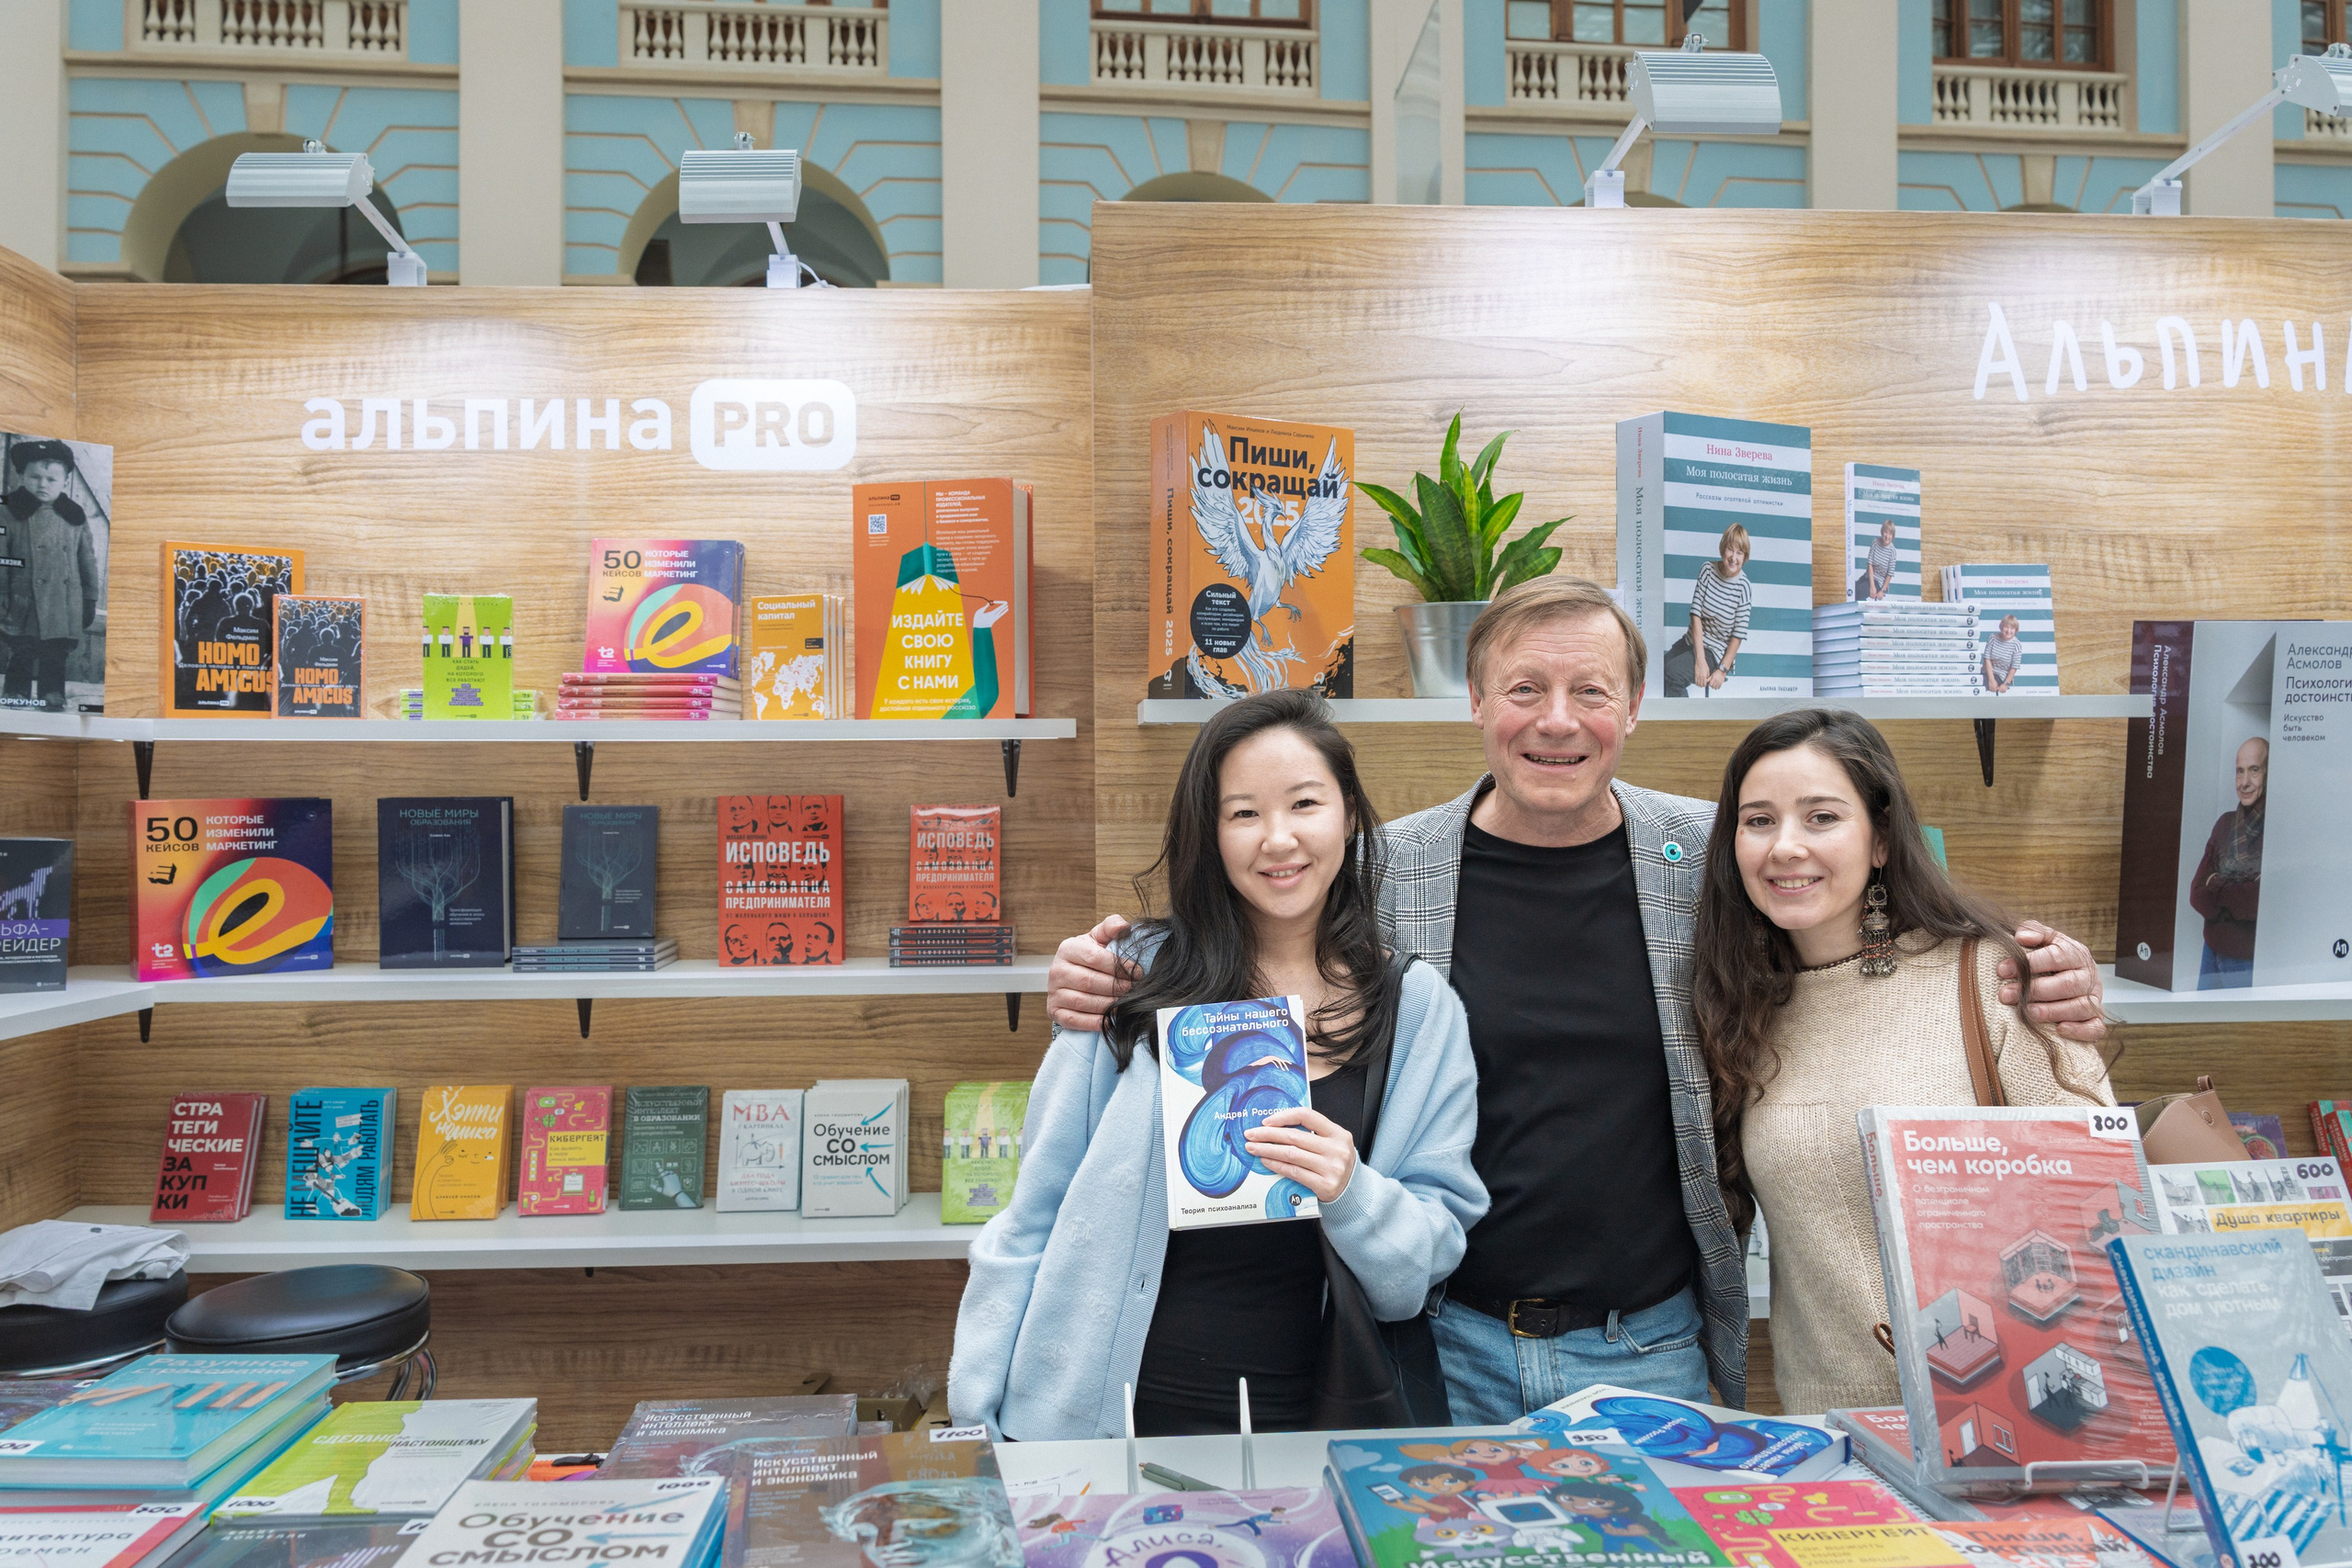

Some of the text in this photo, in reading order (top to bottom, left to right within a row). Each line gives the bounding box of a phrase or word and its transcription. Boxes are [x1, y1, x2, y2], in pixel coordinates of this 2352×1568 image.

[300, 397, 836, 451] альпина PRO
[1229, 435, 1316, 474] Пиши,
[1706, 444, 1773, 462] Нина Зверева
[1196, 468, 1339, 499] сокращай
[1686, 466, 1792, 487] Моя полосатая жизнь
[1635, 486, 1644, 516] Моя
[1696, 492, 1723, 502] Рассказы
[603, 549, 642, 570] 50
[644, 549, 689, 558] КОТОРЫЕ
[643, 560, 696, 569] ИЗМЕНИЛИ
[1166, 487, 1174, 657] Пиши, сокращай 2025
[602, 570, 642, 578] КЕЙСОВ
[643, 570, 699, 579] МАРКЕТИНГ
[1205, 591, 1237, 599] Сильный
[757, 599, 817, 615] Социальный
[757, 615, 796, 626] капитал
[891, 609, 965, 629] ИЗДАЙТЕ
[225, 633, 260, 642] Фельдман
[232, 626, 260, 635] Максим
[901, 634, 954, 649] СВОЮ
[198, 641, 261, 666] HOMO
[904, 654, 953, 669] КНИГУ
[2286, 656, 2343, 670] Асмолов
[196, 668, 274, 693] AMICUS
[294, 667, 339, 685] HOMO
[898, 675, 959, 690] С НАМИ
[292, 686, 354, 705] AMICUS
[2156, 645, 2173, 756] Александр Асмолов
[2284, 692, 2352, 705] достоинст
[2283, 713, 2325, 724] Искусство
[2282, 724, 2303, 732] быть
[2282, 734, 2326, 742] человеком
[205, 815, 265, 826] КОТОРЫЕ
[399, 808, 480, 818] НОВЫЕ МИРЫ
[146, 816, 198, 842] 50
[205, 826, 275, 839] ИЗМЕНИЛИ
[145, 842, 200, 853] КЕЙСОВ
[205, 840, 278, 852] МАРКЕТИНГ
[916, 832, 995, 849] ИСПОВЕДЬ
[725, 840, 831, 865] ИСПОВЕДЬ
[916, 860, 995, 873] САМОЗВАНЦА
[915, 873, 995, 884] ПРЕДПРИНИМАТЕЛЯ
[725, 880, 831, 895] САМОЗВАНЦА
[725, 897, 831, 910] ПРЕДПРИНИМАТЕЛЯ
[0, 936, 62, 953] ЕЙДЕР
[1204, 1007, 1289, 1024] Тайны нашего
[1182, 1019, 1290, 1037] бессознательного
[175, 1101, 223, 1116] СТРА
[428, 1085, 503, 1124] Хэппи
[639, 1113, 701, 1122] ОБРАЗОВАНИИ
[1214, 1109, 1249, 1121] Андрей
[172, 1120, 219, 1134] ТЕГИ
[813, 1122, 891, 1144] Обучение
[168, 1138, 243, 1153] ЧЕСКИЕ
[1903, 1129, 2008, 1156] Больше,
[163, 1156, 193, 1172] ЗА
[288, 1099, 323, 1218] НЕ МЕШАЙТЕ
[355, 1099, 379, 1217] ЛЮДЯМ РАБОТАТЬ
[1906, 1154, 2074, 1181] чем коробка
[2296, 1162, 2335, 1179] 600
[160, 1175, 208, 1190] КУП
[1924, 1184, 1991, 1194] безграничном
[156, 1193, 188, 1210] КИ
[1181, 1202, 1258, 1215] Теория психоанализа
[1914, 1196, 1971, 1206] потенциале
[1917, 1208, 1987, 1219] ограниченного
[2215, 1210, 2341, 1228] Душа квартиры
[1918, 1220, 1985, 1231] пространства
[147, 1357, 311, 1368] Разумное
[645, 1409, 752, 1423] Искусственный
[640, 1419, 716, 1429] интеллект
[311, 1433, 399, 1445] СДЕЛАНО
[647, 1427, 727, 1437] экономика
[1571, 1433, 1609, 1443] 950
[389, 1438, 491, 1448] НАСТОЯЩЕМУ
[752, 1450, 878, 1469] Искусственный
[752, 1462, 839, 1478] интеллект
[764, 1470, 859, 1486] экономика
[458, 1511, 686, 1530] Обучение
[1968, 1529, 2084, 1543] Пиши,
[1104, 1531, 1224, 1568] Алиса,
